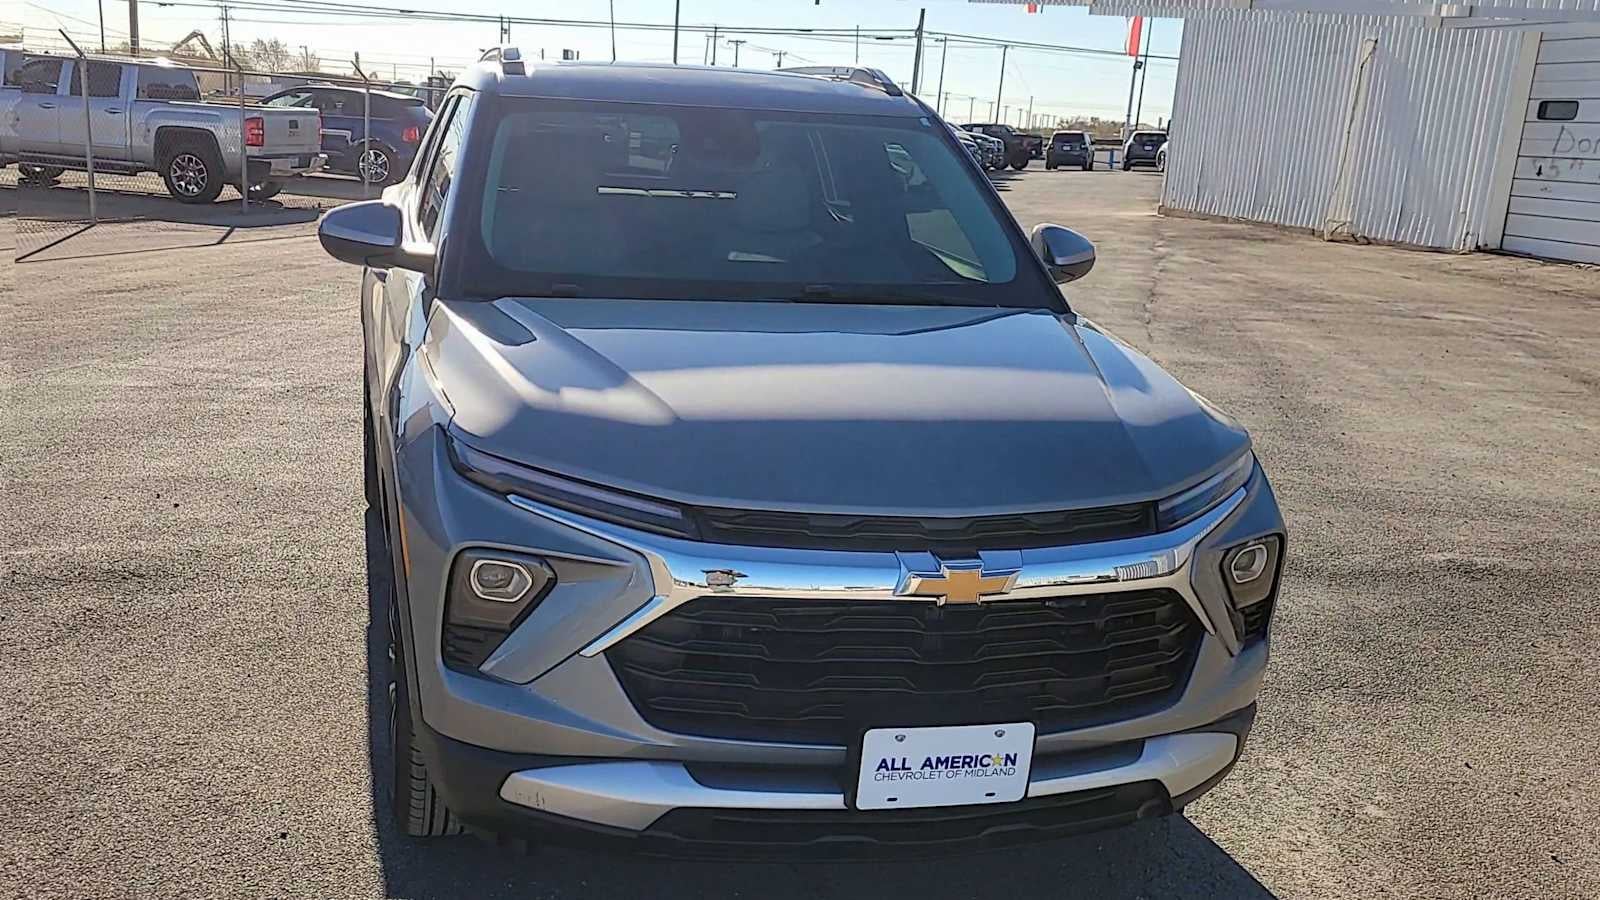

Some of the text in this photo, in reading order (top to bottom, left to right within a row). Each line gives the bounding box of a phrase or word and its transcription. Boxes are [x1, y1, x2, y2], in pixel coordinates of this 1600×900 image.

[876, 753, 1018, 772] ALL AMERICN
[874, 767, 1016, 781] CHEVROLET OF MIDLAND
